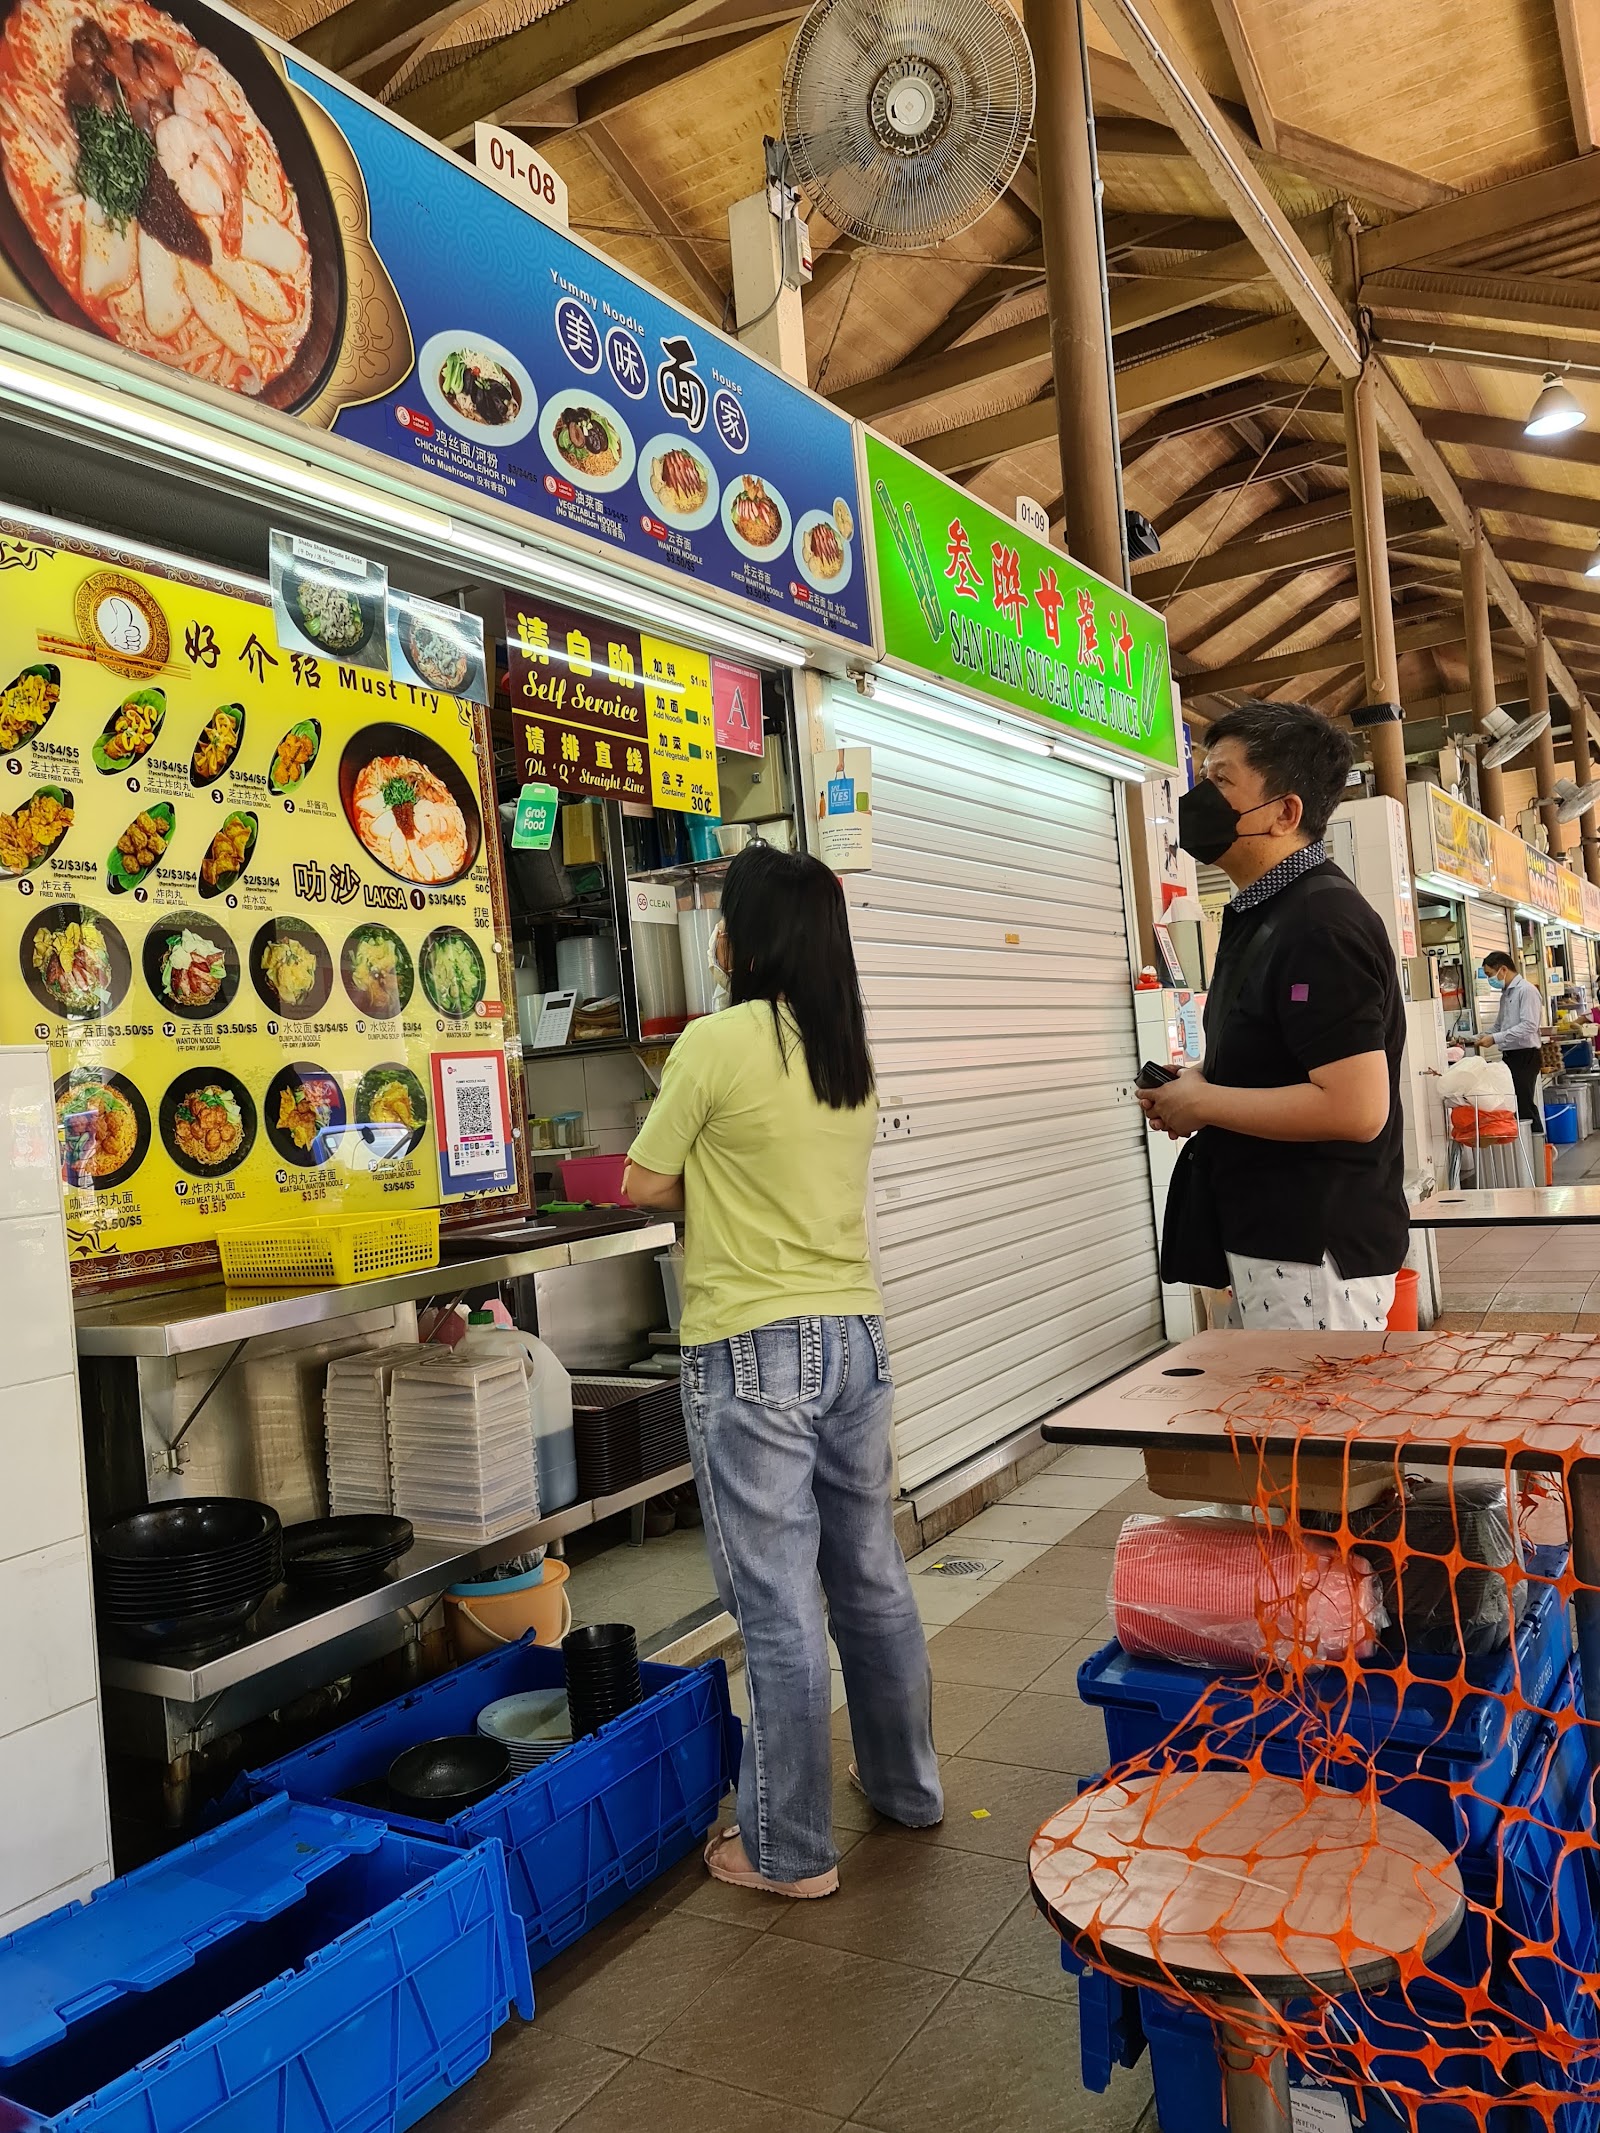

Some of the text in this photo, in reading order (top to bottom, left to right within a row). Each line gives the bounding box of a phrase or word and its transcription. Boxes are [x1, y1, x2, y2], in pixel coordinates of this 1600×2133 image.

[490, 137, 556, 205] 01-08
[550, 268, 743, 395] Yummy Noodle House
[414, 436, 516, 488] CHICKEN NOODLE/HOR FUN
[422, 452, 475, 482] (No Mushroom
[575, 489, 604, 514] 油菜面
[556, 505, 600, 530] (No Mushroom
[558, 498, 622, 530] VEGETABLE NOODLE
[1021, 503, 1046, 532] 01-09
[667, 530, 692, 551] 云吞面
[657, 540, 703, 565] WANTON NOODLE
[666, 553, 695, 572] $3.50/$5
[731, 571, 745, 585] FRIED
[746, 577, 766, 592] WANTON
[766, 584, 784, 599] NOODLE
[184, 619, 321, 689] 好介绍
[517, 611, 635, 690] 请自助
[645, 672, 656, 681] Add
[950, 610, 1140, 740] SAN LIAN SUGAR CANE JUICE
[338, 666, 440, 714] Must Try
[522, 670, 640, 723] Self Service
[656, 695, 711, 726] 加面 $1
[727, 685, 750, 729] A
[653, 710, 683, 724] Add Noodle
[31, 740, 80, 758] $3/$4/$5
[525, 723, 644, 775] 请排直线
[653, 748, 690, 762] Add Vegetable
[705, 749, 713, 760] $1
[10, 760, 19, 773] 5
[147, 757, 189, 774] $3/$4/$5
[28, 771, 84, 784] CHEESE FRIED WANTON
[229, 769, 267, 785] $3/$4/$5
[525, 757, 548, 778] Pls
[579, 768, 622, 792] Straight
[622, 776, 645, 794] Line
[662, 771, 684, 787] 盒子
[129, 780, 138, 791] 4
[144, 786, 160, 795] CHEESE
[160, 788, 173, 796] FRIED
[214, 792, 221, 802] 3
[661, 786, 712, 814] Container 30¢
[832, 791, 849, 802] YES
[286, 801, 293, 812] 2
[525, 806, 547, 819] Grab
[523, 818, 546, 830] Food
[51, 858, 98, 872] $2/$3/$4
[156, 868, 197, 881] $2/$3/$4
[243, 874, 280, 887] $2/$3/$4
[470, 873, 490, 884] Gravy
[22, 880, 72, 893] 8 炸云吞
[137, 888, 183, 901] 7 炸肉丸
[228, 896, 236, 907] 6
[363, 884, 467, 910] LAKSA 1 $3/$4/$5
[638, 897, 671, 909] SG CLEAN
[474, 907, 489, 918] 打包
[36, 1025, 154, 1038] 13 $3.50/$5
[163, 1023, 258, 1035] 12 云吞面 $3.50/$5
[268, 1022, 349, 1034] 11 水饺面 $3/$4/$5
[402, 1022, 422, 1031] $3/$4
[474, 1021, 492, 1030] $3/$4
[199, 1036, 220, 1044] NOODLE
[302, 1034, 322, 1042] NOODLE
[446, 1031, 462, 1039] WANTON
[277, 1169, 336, 1185] 16 肉丸云吞面
[385, 1172, 405, 1180] DUMPLING
[405, 1169, 421, 1177] NOODLE
[176, 1179, 235, 1196] 17 炸肉丸面
[280, 1179, 343, 1193] MEAT BALL WANTON NOODLE
[383, 1181, 415, 1192] $3/$4/$5
[180, 1191, 246, 1206] FRIED MEAT BALL NOODLE
[118, 1204, 141, 1214] NOODLE
[93, 1215, 142, 1232] $3.50/$5
